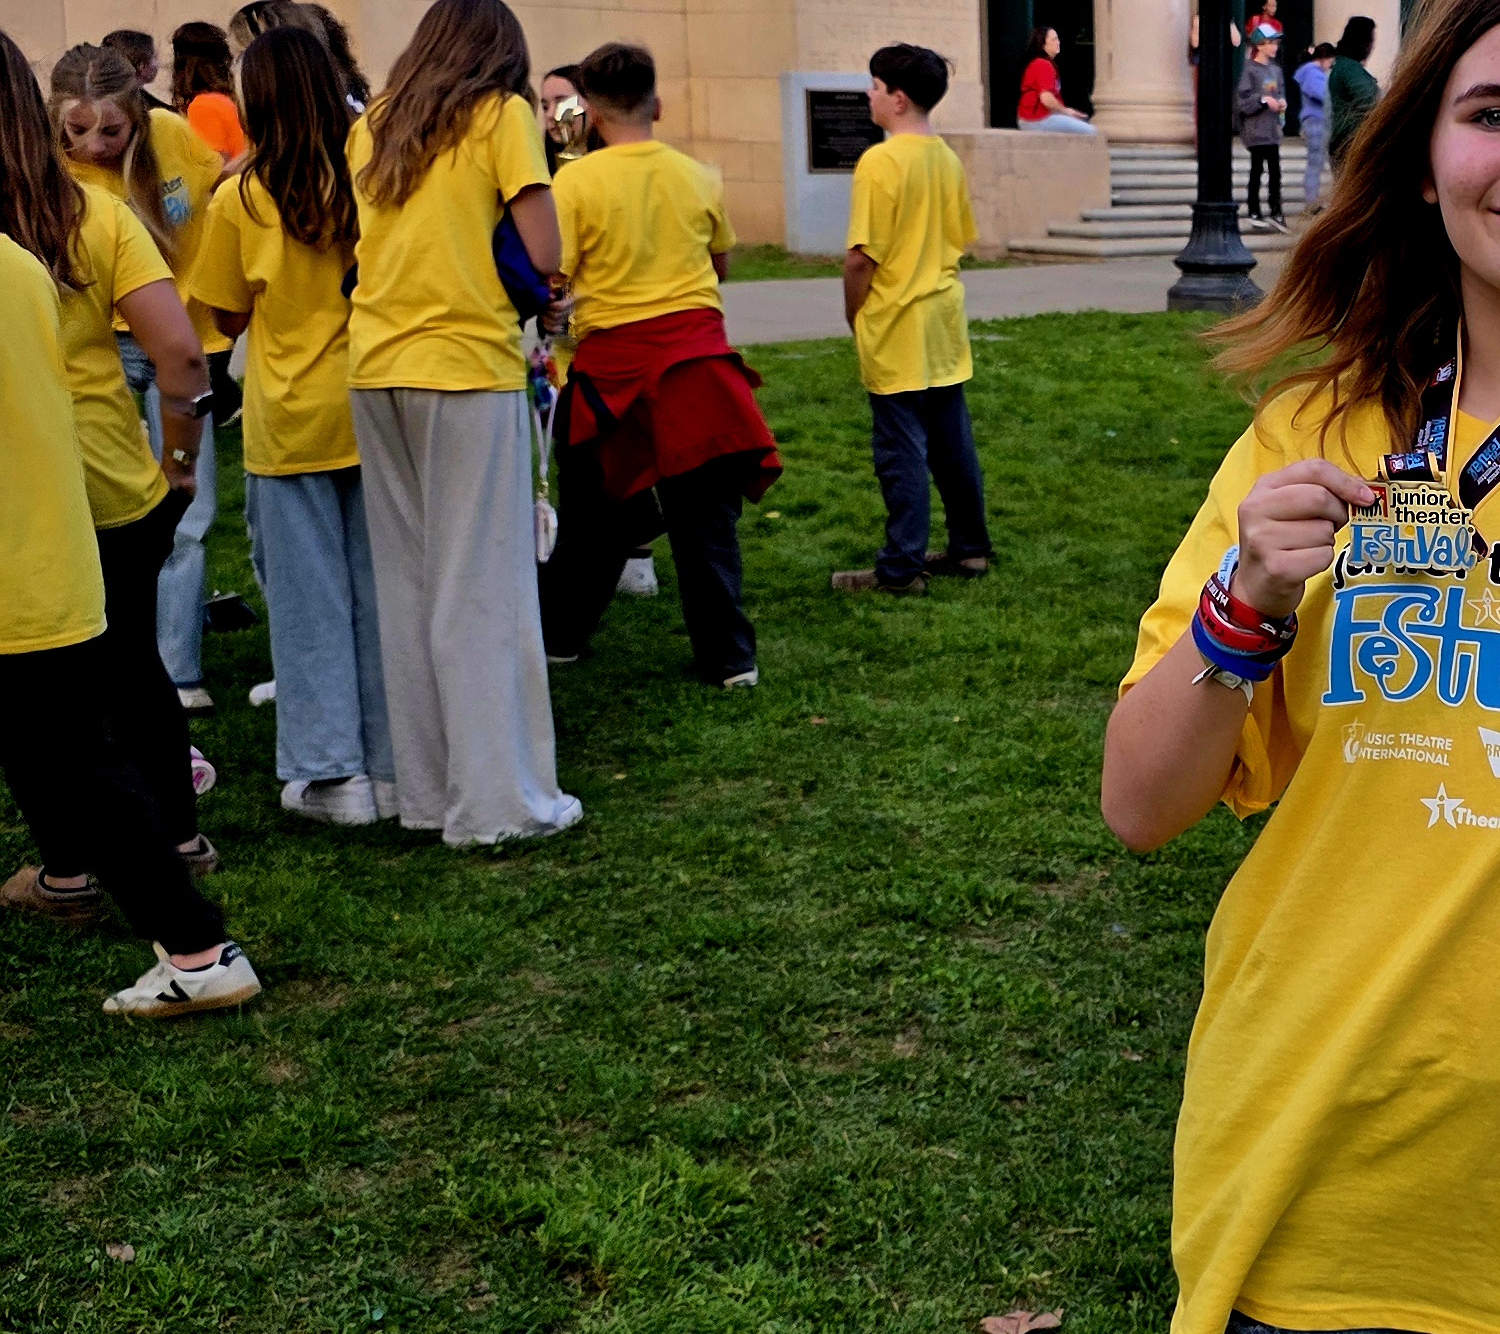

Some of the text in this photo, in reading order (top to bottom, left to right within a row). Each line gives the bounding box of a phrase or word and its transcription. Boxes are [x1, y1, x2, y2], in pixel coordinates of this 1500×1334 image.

[1390, 487, 1448, 508] junior
[1395, 507, 1469, 525] theater
[1399, 733, 1453, 751] THEATRE
[1359, 747, 1450, 766] NTERNATIONAL
